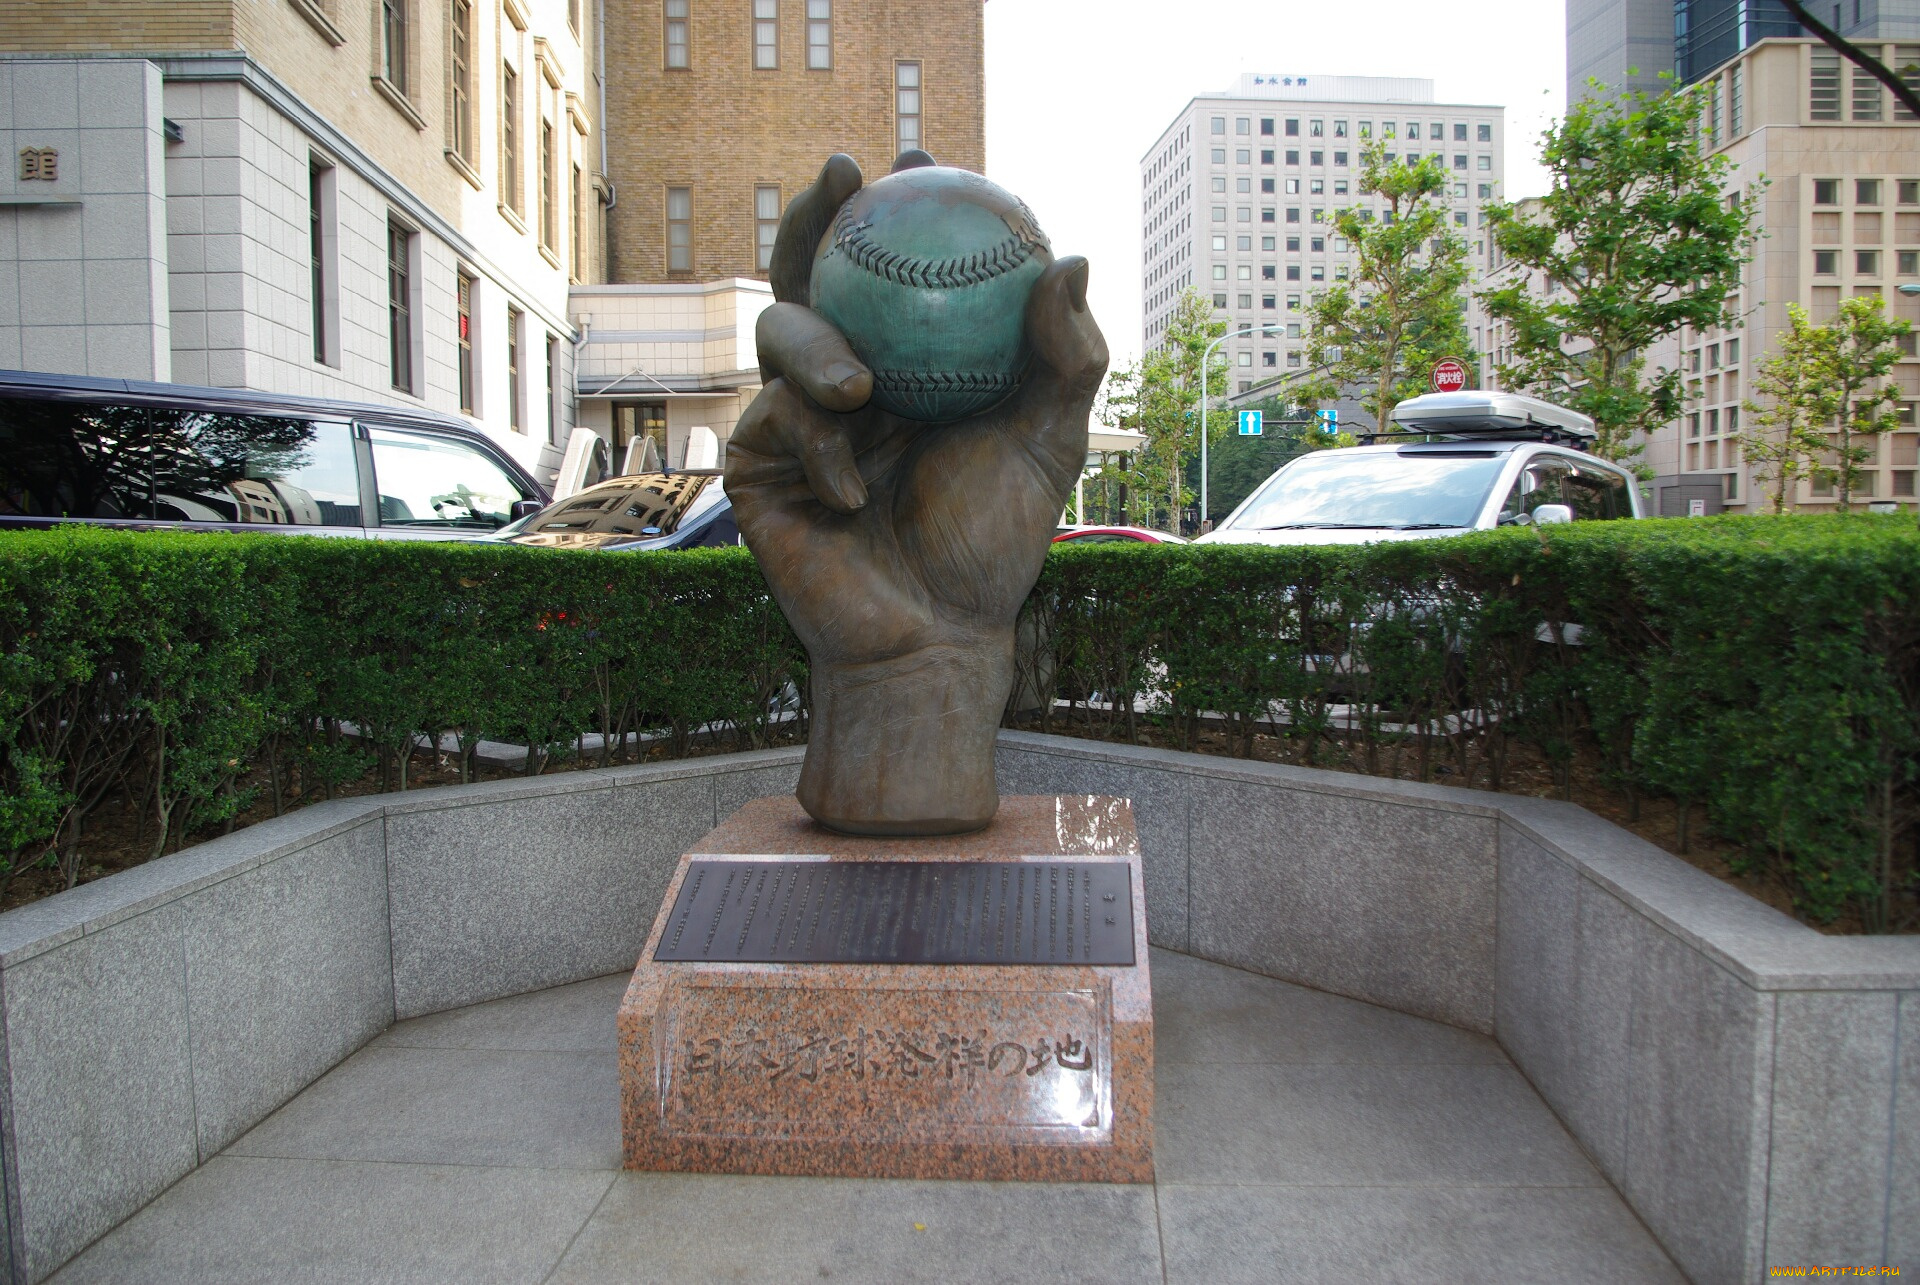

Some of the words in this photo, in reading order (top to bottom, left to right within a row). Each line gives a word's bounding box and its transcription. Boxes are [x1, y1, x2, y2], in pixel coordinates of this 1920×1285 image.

[19, 145, 59, 181] 館
[1437, 371, 1463, 385] 消火栓
[684, 1028, 1093, 1092] 日本野球発祥の地
